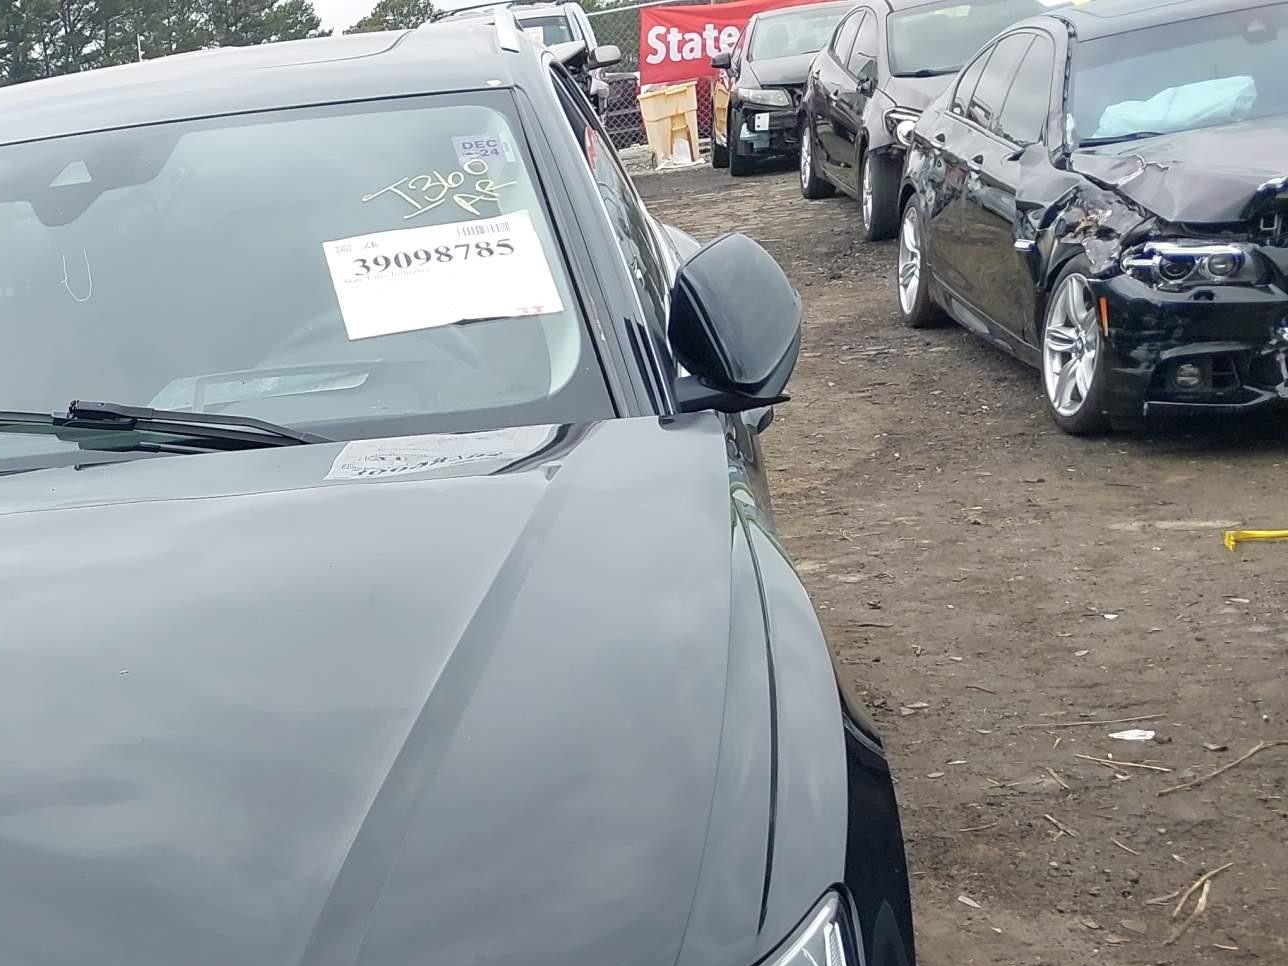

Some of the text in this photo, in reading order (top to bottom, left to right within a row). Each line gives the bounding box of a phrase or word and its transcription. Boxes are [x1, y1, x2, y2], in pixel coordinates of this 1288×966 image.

[646, 24, 739, 64] State
[462, 139, 498, 149] DEC
[353, 238, 515, 276] 39098785
